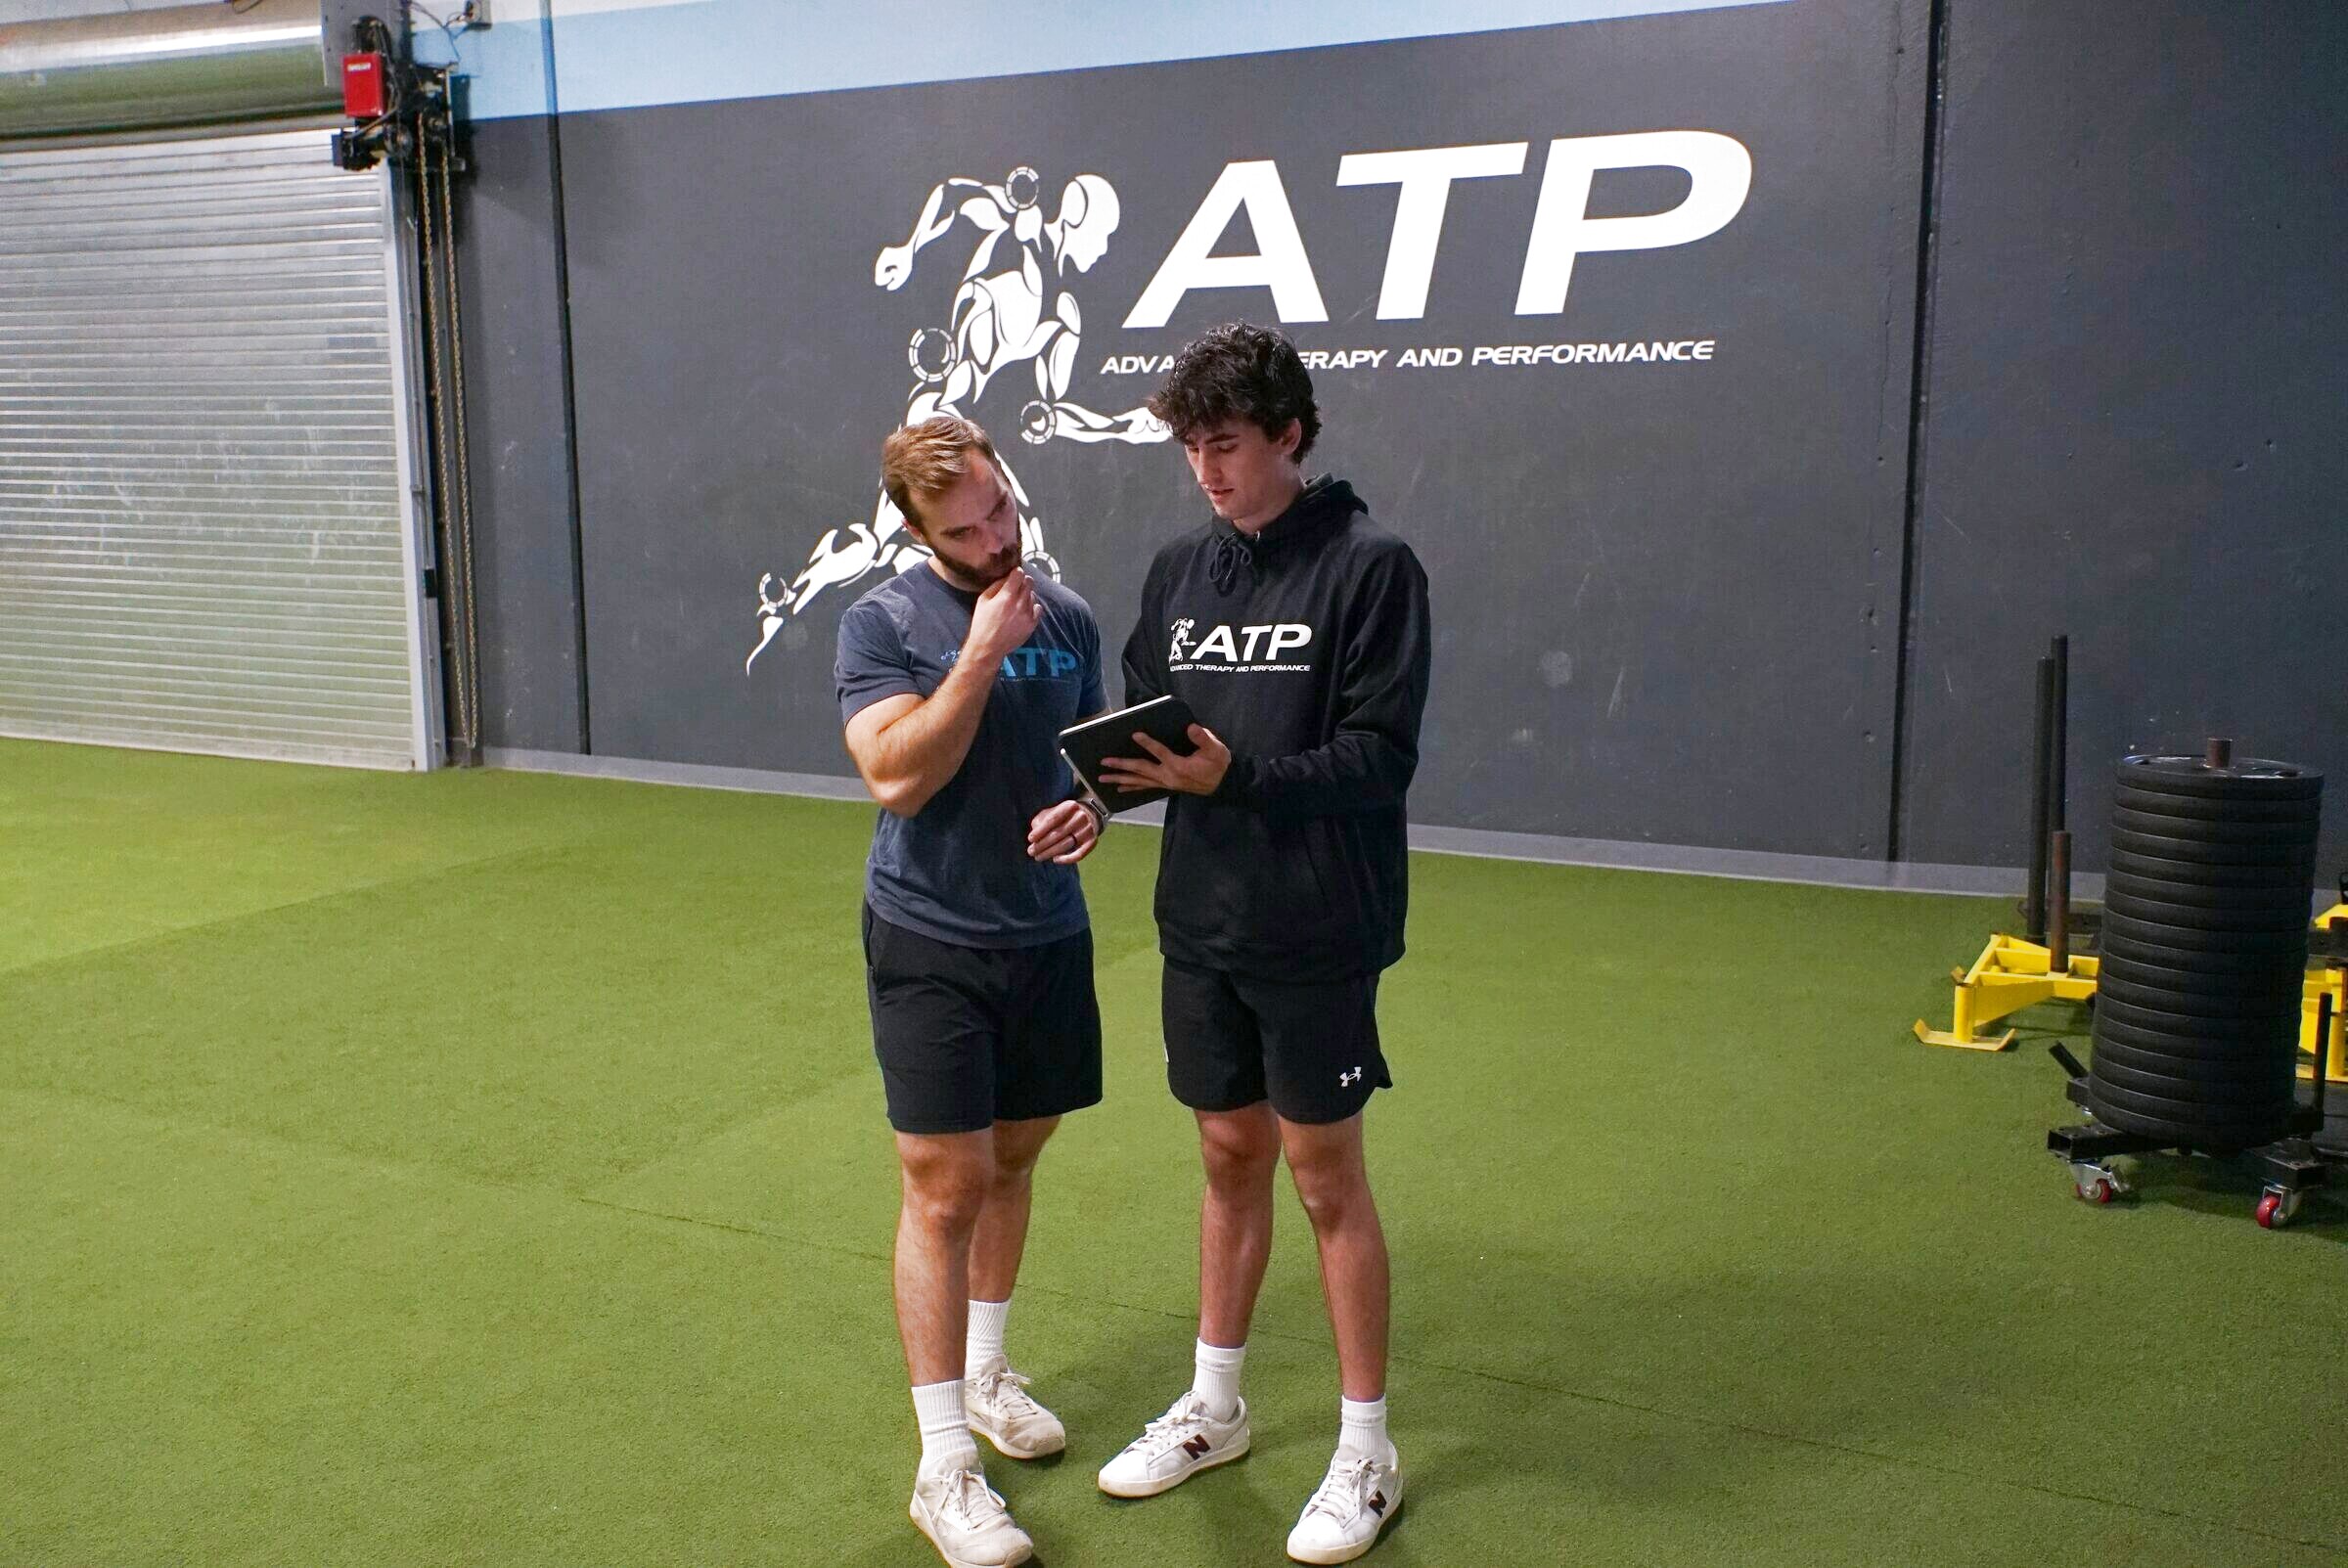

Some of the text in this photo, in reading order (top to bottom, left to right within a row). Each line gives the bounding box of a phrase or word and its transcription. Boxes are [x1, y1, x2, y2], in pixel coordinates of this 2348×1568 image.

[1121, 130, 1753, 329] ATP
[1101, 340, 1715, 375] ADVA ERAPY AND PERFORMANCE
[1190, 623, 1313, 662] ATP
[1195, 663, 1235, 673] THERAPY
